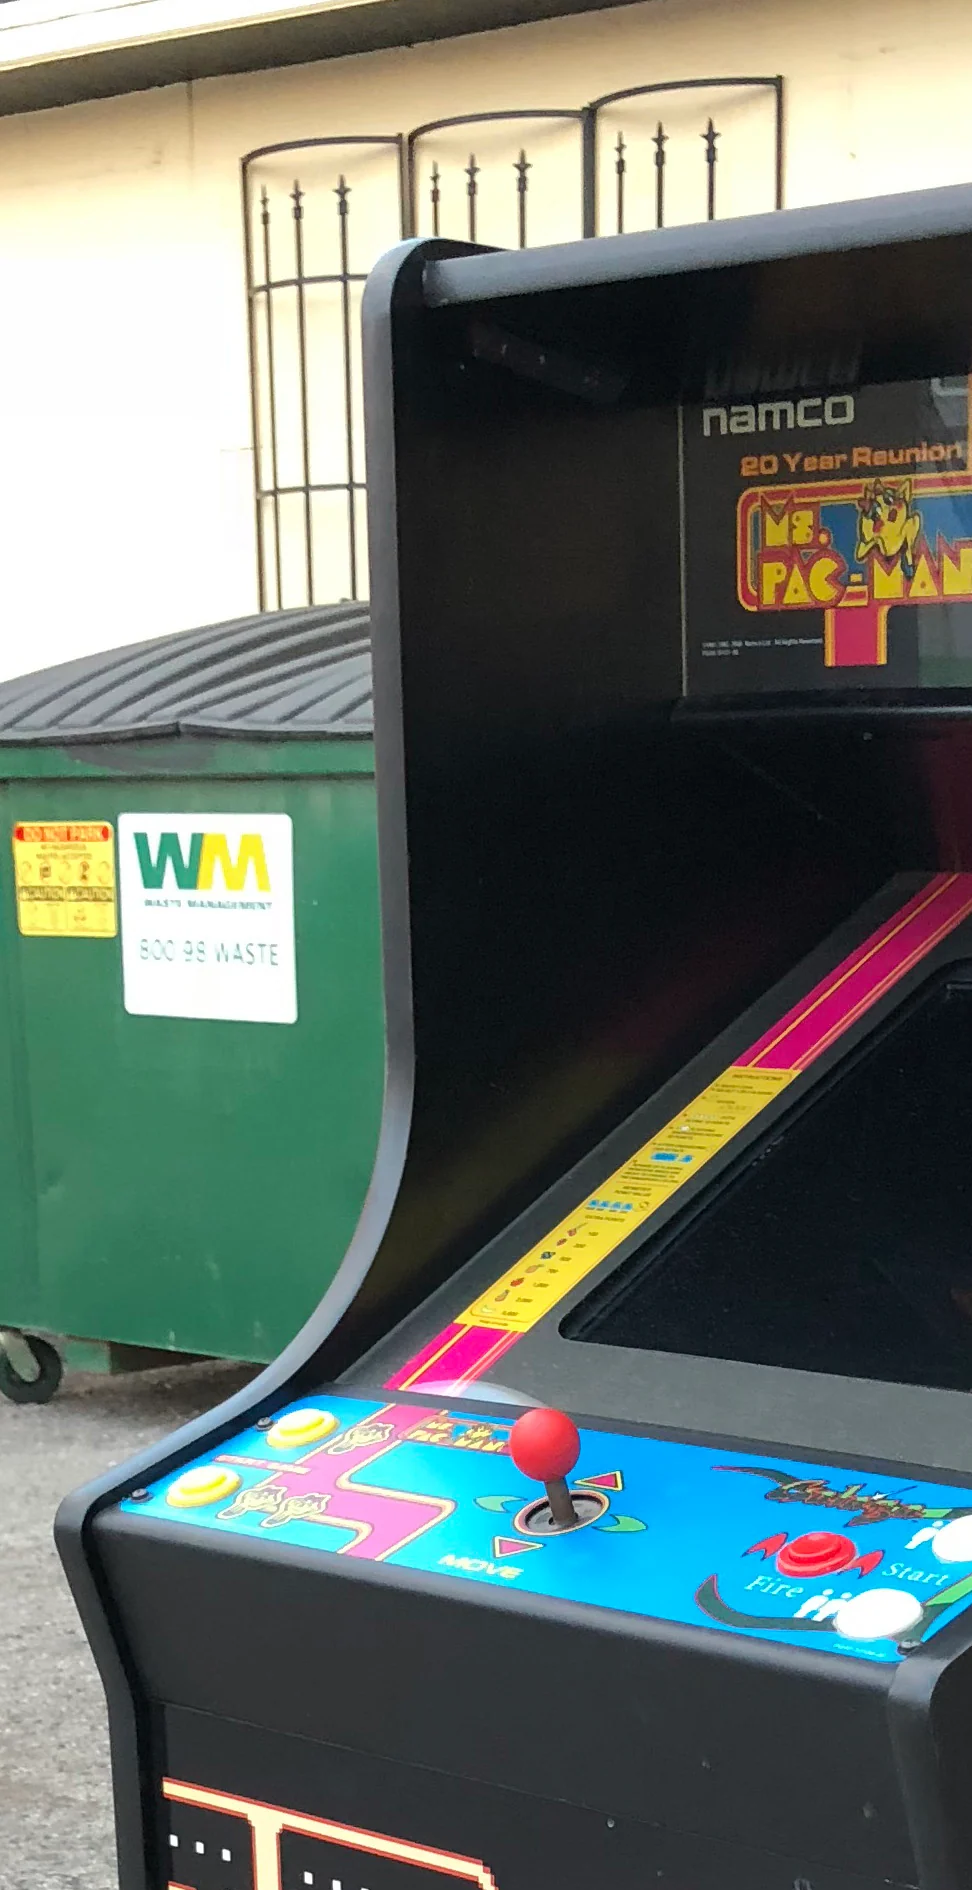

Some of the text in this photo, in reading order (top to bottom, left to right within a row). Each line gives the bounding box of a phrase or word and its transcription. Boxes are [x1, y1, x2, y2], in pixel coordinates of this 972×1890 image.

[702, 395, 855, 437] namco
[740, 441, 962, 477] 20 Year Reunion
[133, 832, 271, 892] WM
[215, 942, 279, 966] WASTE
[437, 1553, 525, 1581] MOVE
[881, 1561, 951, 1588] Start
[743, 1574, 804, 1600] Fire
